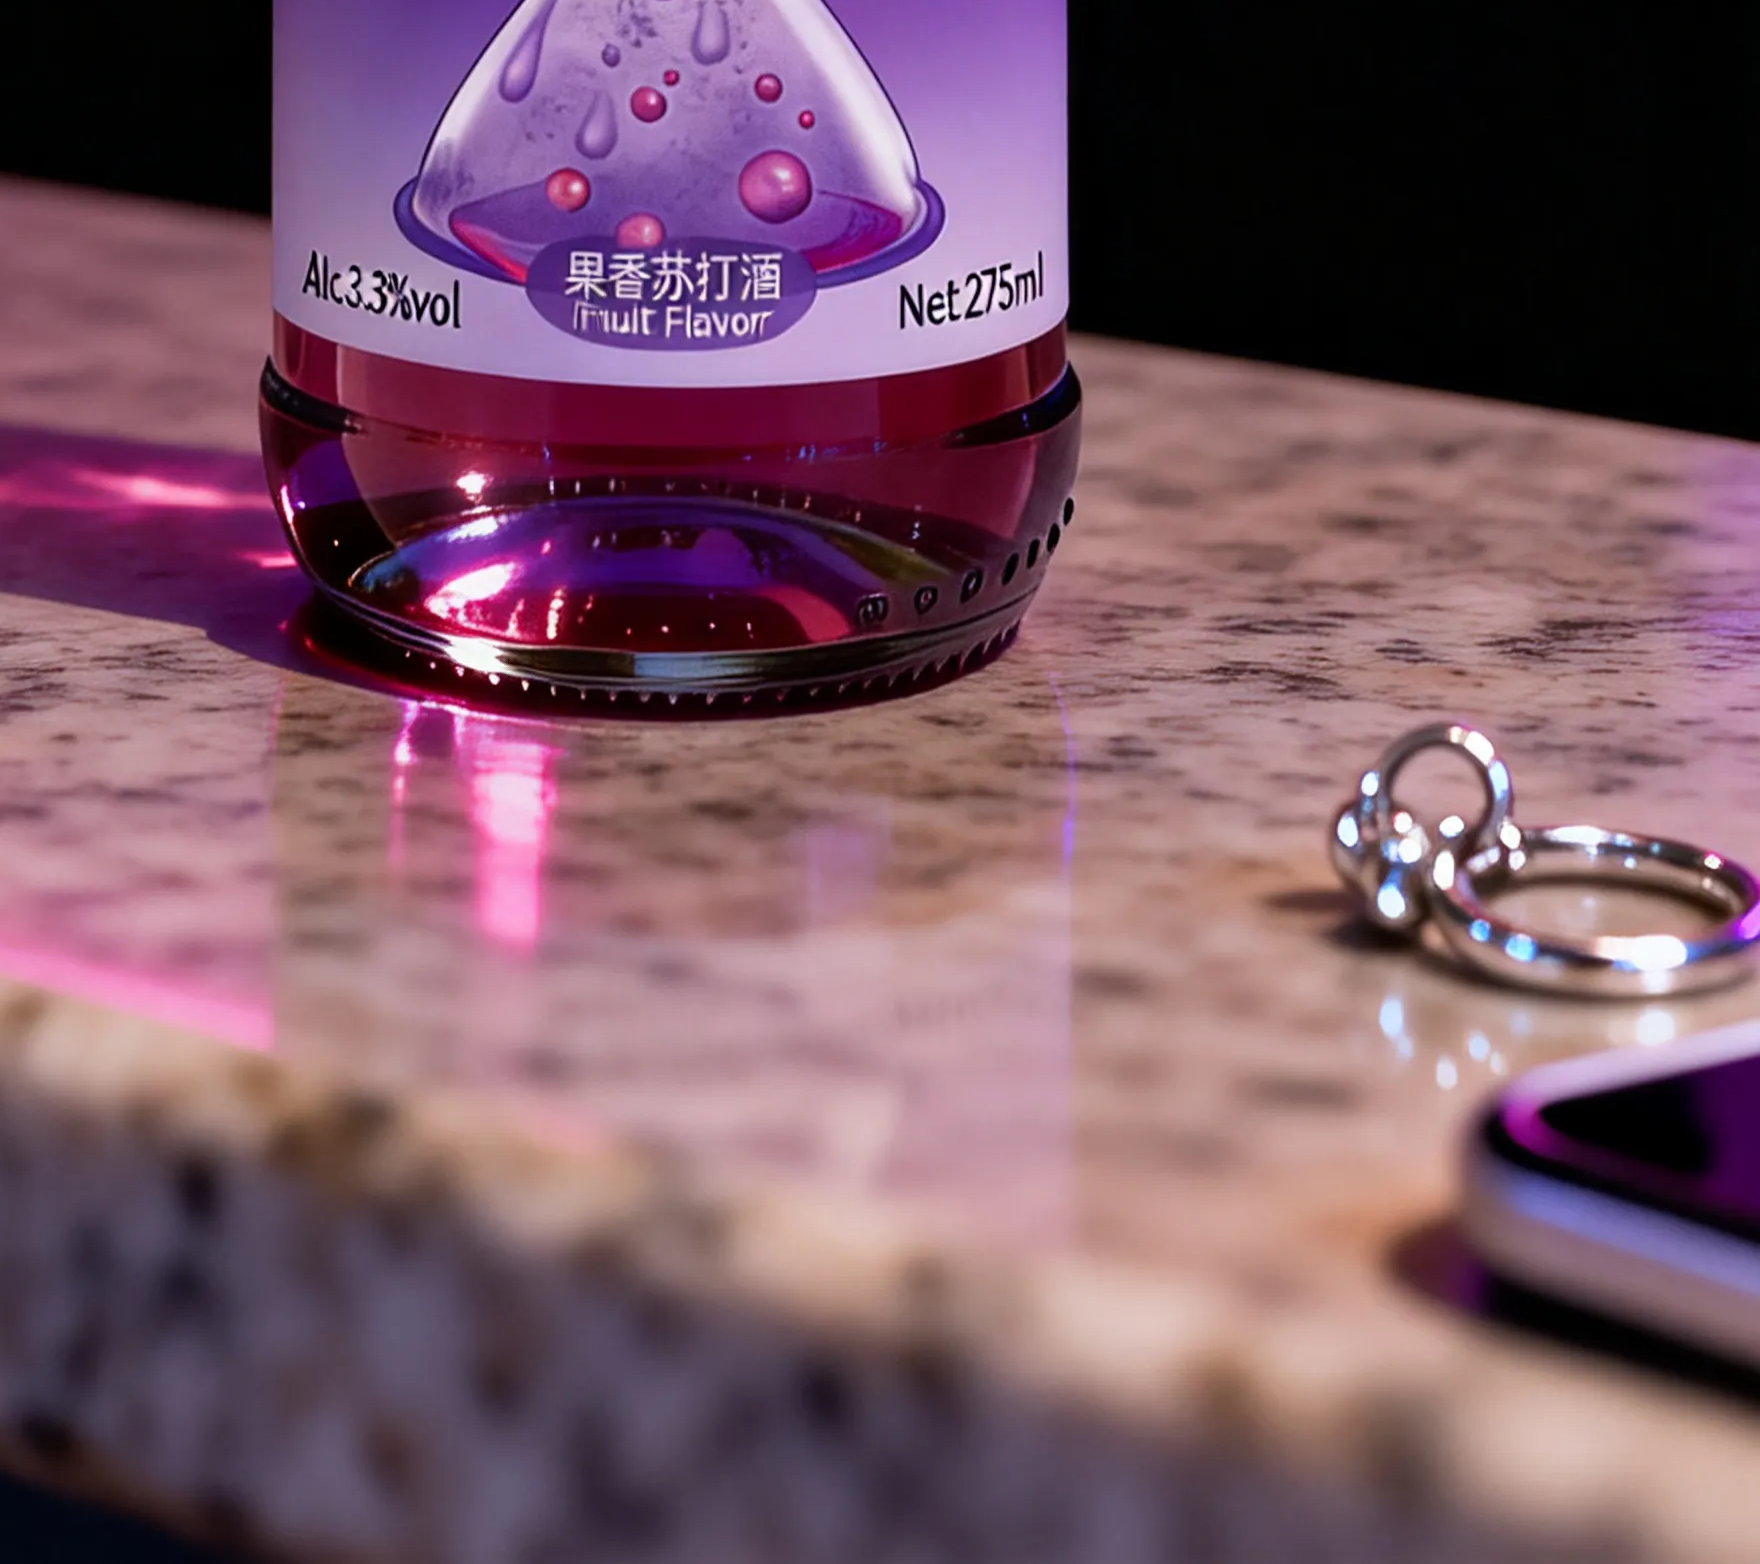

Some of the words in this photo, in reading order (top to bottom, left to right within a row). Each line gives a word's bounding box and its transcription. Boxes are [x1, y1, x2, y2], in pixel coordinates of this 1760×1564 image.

[563, 248, 784, 302] 果香苏打酒
